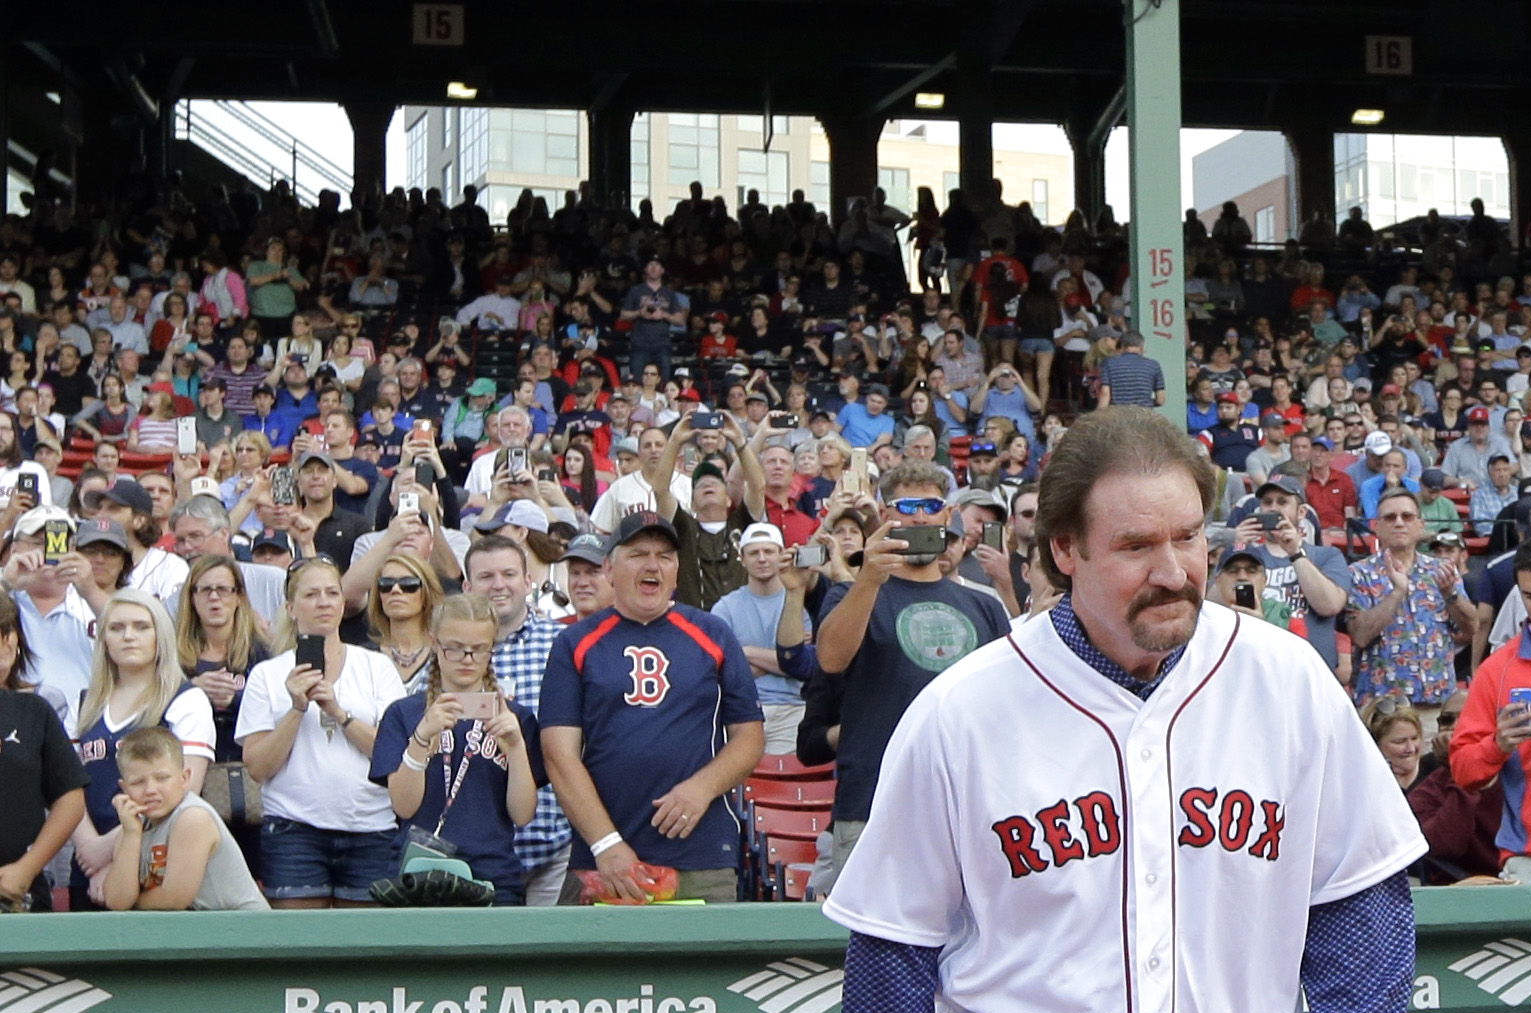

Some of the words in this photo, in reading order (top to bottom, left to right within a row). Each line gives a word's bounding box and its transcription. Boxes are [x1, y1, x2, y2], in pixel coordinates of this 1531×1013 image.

[424, 9, 451, 40] 15
[1376, 37, 1401, 62] 16
[1148, 248, 1174, 277] 15
[1150, 298, 1175, 328] 16
[46, 531, 68, 553] M
[623, 645, 672, 707] B
[81, 739, 106, 765] ED
[991, 790, 1121, 879] RED
[1178, 786, 1287, 862] SOX
